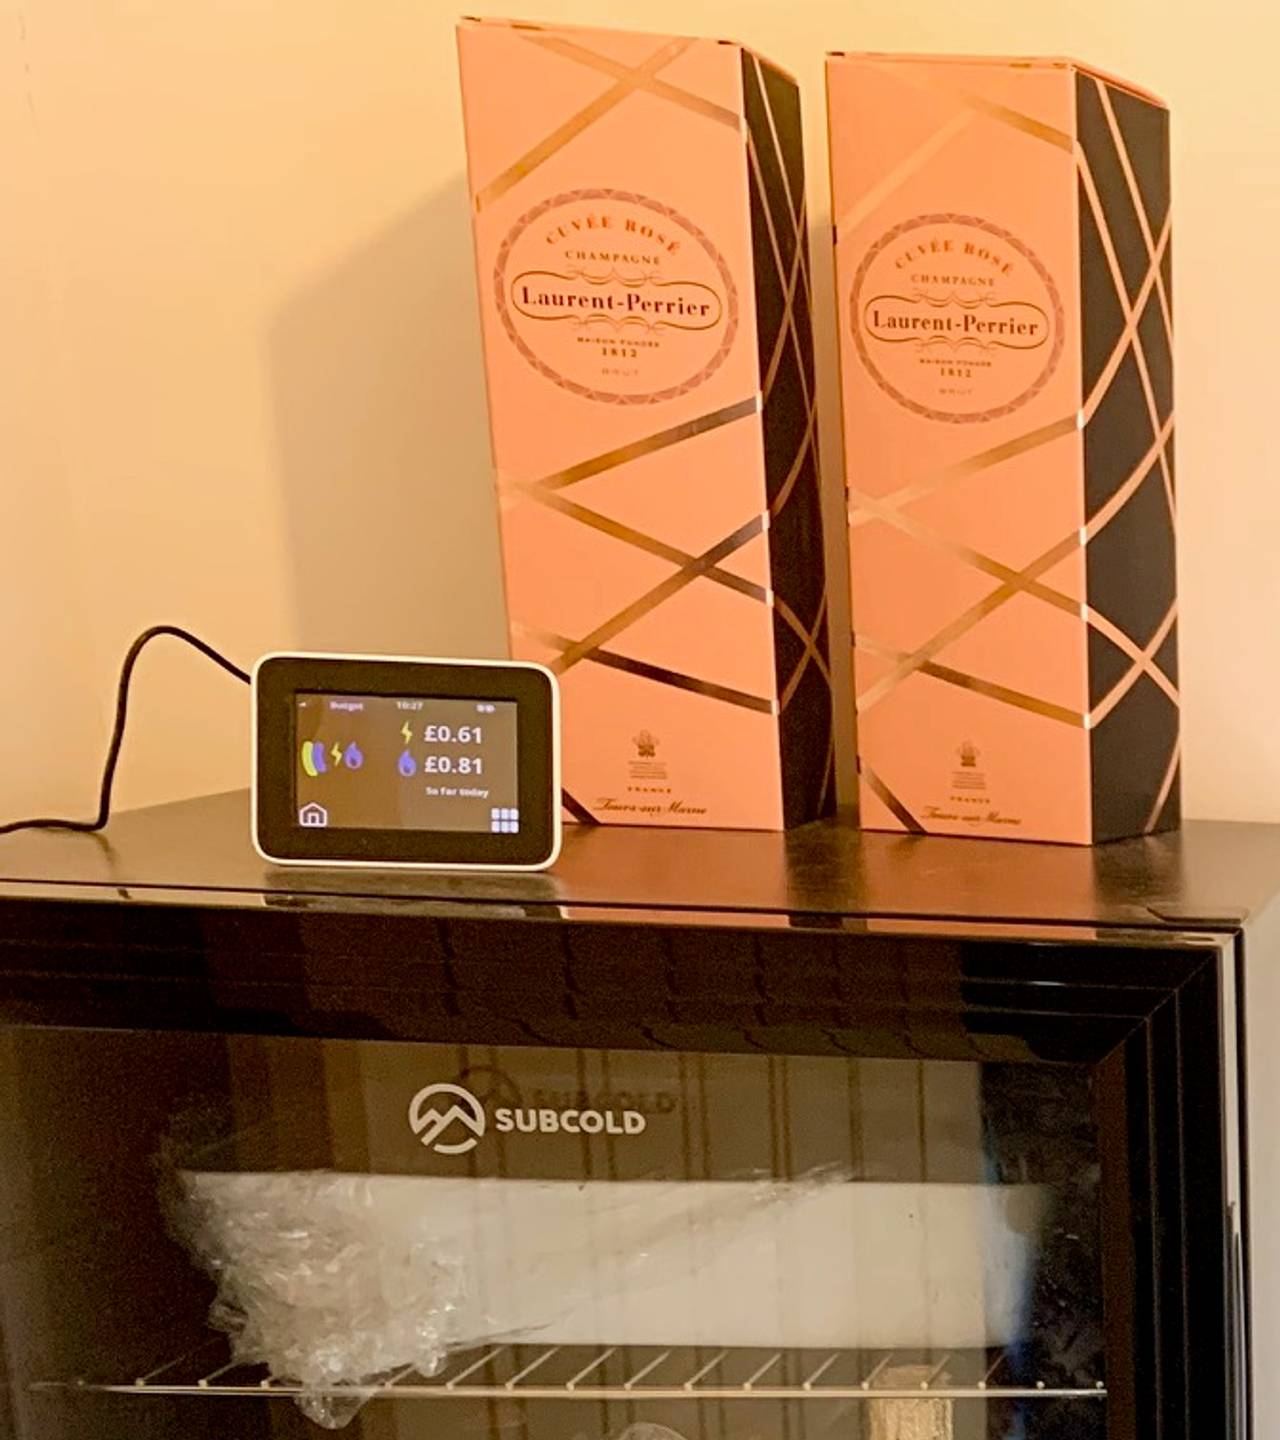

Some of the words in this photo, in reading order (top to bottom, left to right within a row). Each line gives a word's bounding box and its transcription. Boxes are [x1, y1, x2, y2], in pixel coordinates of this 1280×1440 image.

[565, 250, 660, 266] CHAMPAGNE
[911, 273, 995, 288] CHAMPAGNE
[521, 285, 711, 317] Laurent-Perrier
[873, 309, 1039, 336] Laurent-Perrier
[602, 347, 638, 358] 1812
[940, 367, 972, 378] 1812
[424, 725, 482, 744] £0.61
[424, 756, 482, 774] £0.81
[426, 787, 439, 796] So
[440, 787, 457, 796] far
[460, 787, 489, 799] today
[495, 1108, 647, 1135] SUBCOLD
